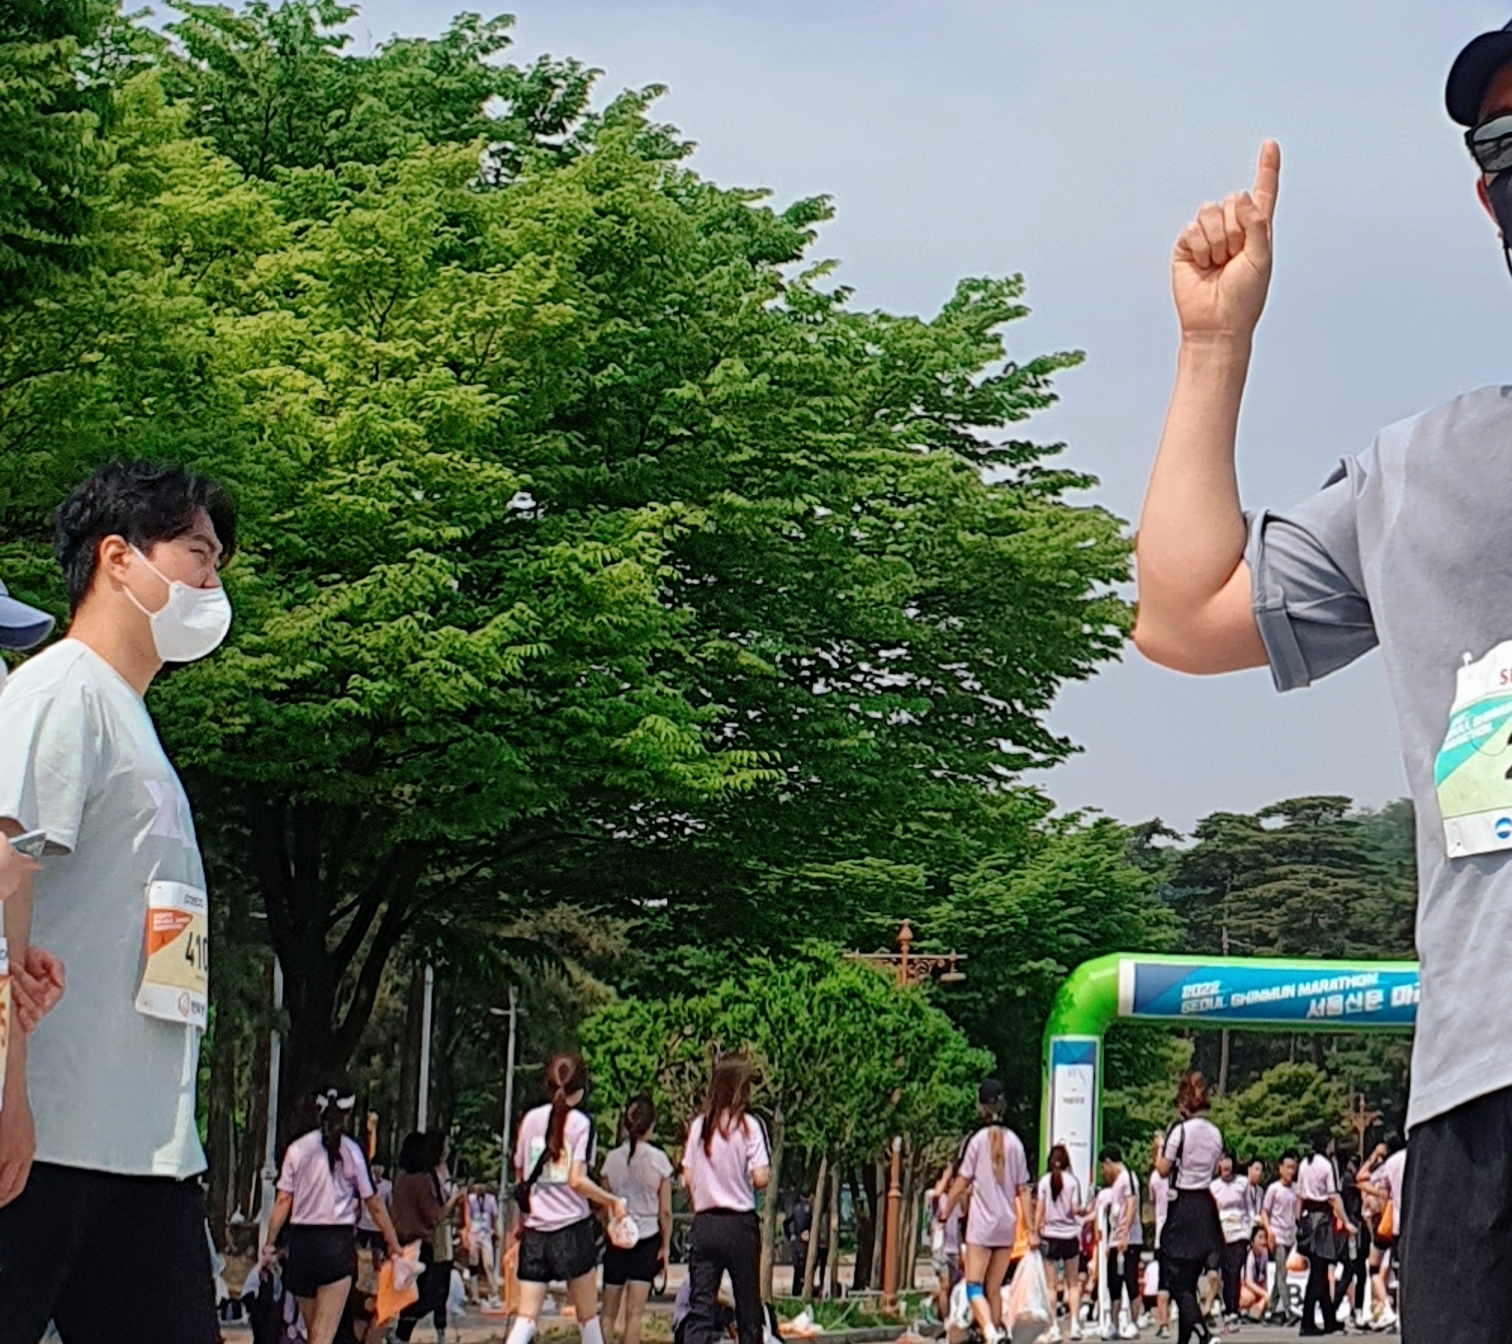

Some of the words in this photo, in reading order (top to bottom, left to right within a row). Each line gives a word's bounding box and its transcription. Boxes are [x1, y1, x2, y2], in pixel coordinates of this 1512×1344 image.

[1181, 996, 1226, 1014] SEOUL
[1297, 972, 1379, 997] MARATHON
[1182, 980, 1221, 999] 2022
